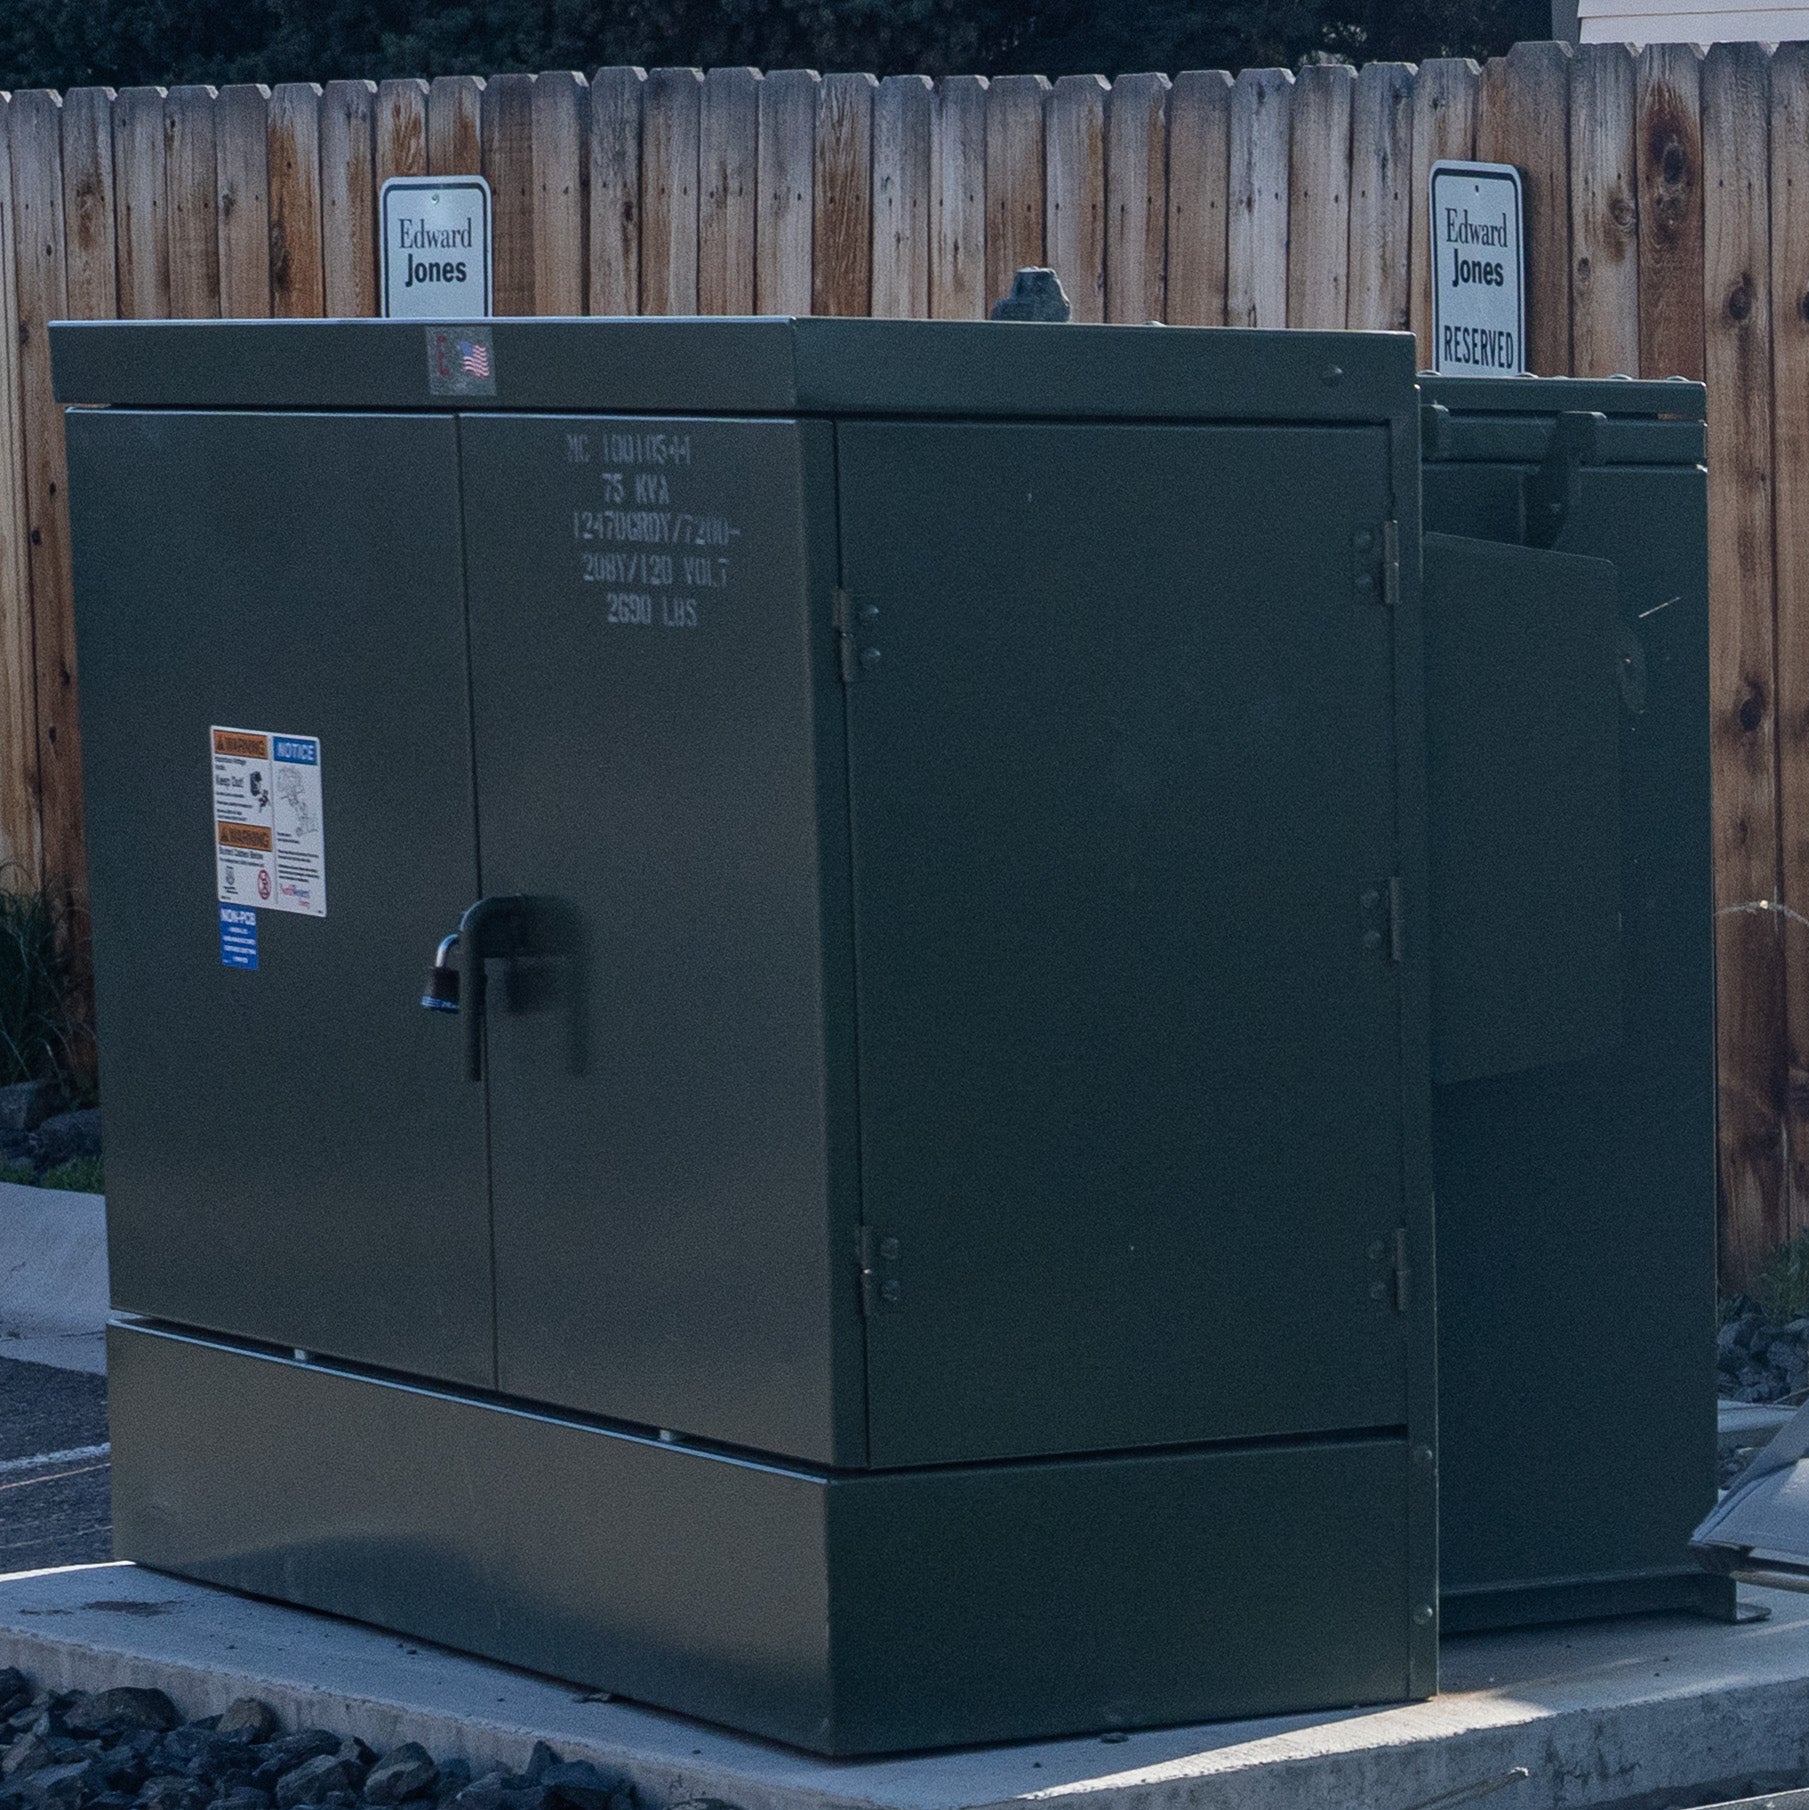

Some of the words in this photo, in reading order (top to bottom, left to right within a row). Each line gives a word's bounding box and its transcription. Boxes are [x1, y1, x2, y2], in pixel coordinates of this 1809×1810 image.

[398, 217, 473, 249] Edward
[1445, 208, 1508, 248] Edward
[405, 253, 467, 288] Jones
[1452, 248, 1504, 287] Jones
[1444, 325, 1514, 369] RESERVED
[277, 742, 314, 761] NOTICE
